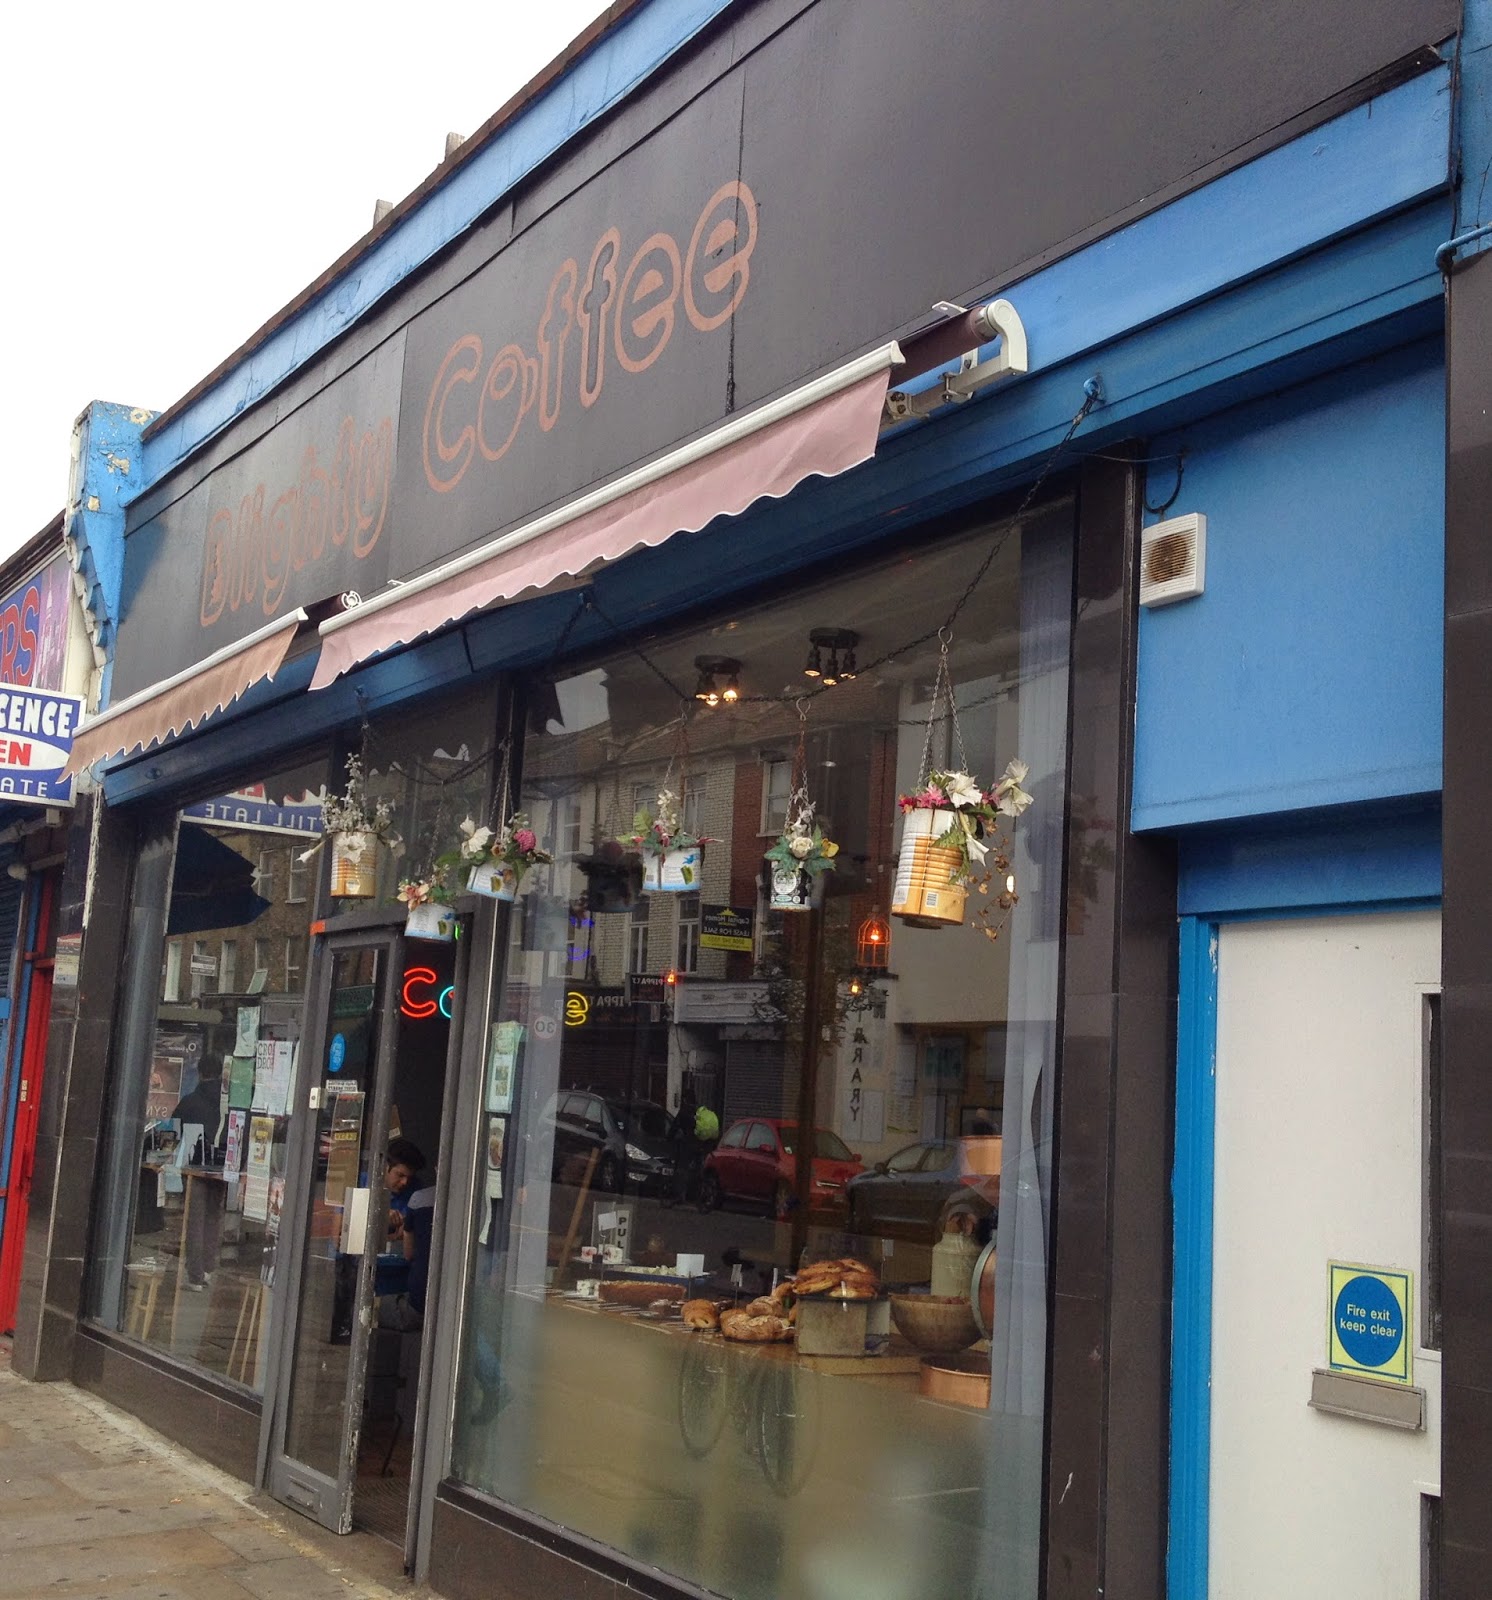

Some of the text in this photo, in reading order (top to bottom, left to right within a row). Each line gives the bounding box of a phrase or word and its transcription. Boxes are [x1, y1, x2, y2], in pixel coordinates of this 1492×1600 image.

[422, 180, 759, 493] Coffee
[1347, 1303, 1391, 1322] Fire exit
[1340, 1317, 1397, 1337] keep clear
